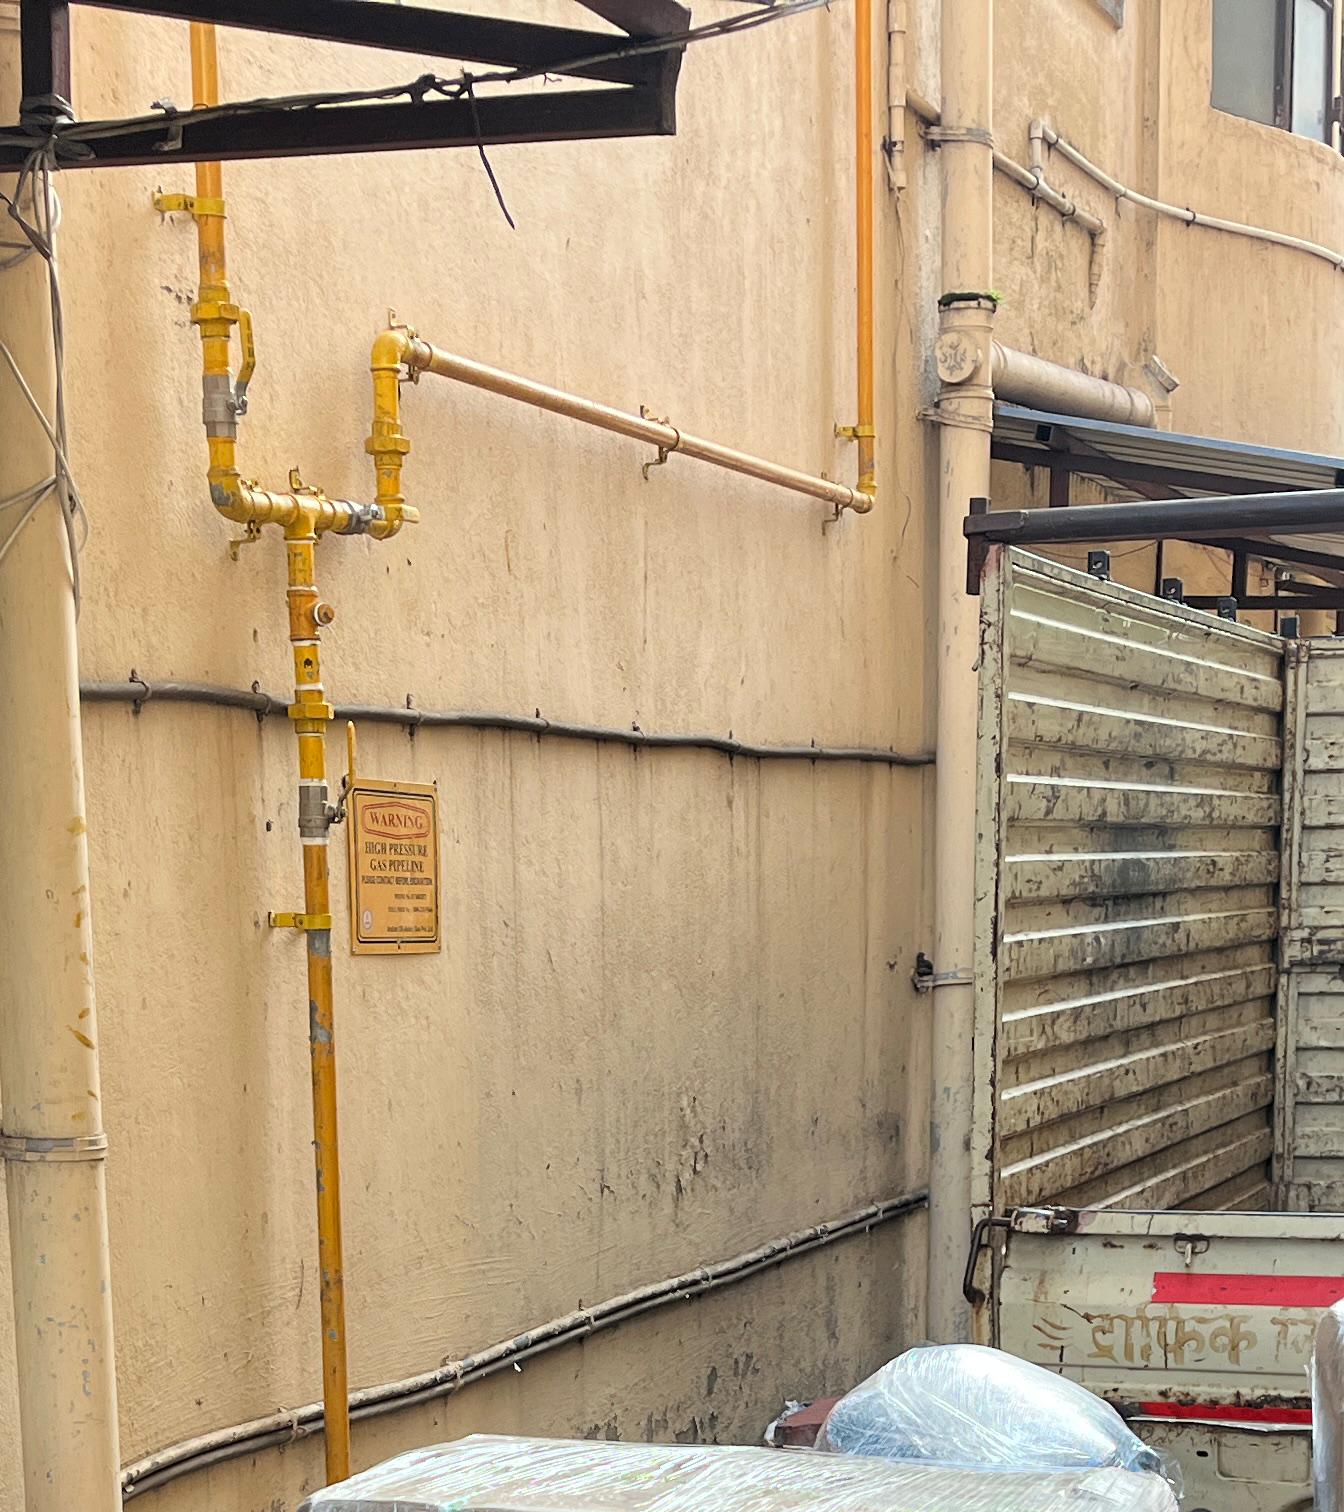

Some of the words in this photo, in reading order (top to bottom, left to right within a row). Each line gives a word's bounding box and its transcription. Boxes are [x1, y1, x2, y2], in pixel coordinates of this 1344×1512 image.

[370, 811, 423, 829] WARNING
[365, 841, 387, 856] HIGH
[389, 843, 428, 858] PRESSURE
[370, 858, 387, 872] GAS
[389, 860, 425, 874] PIPELINE
